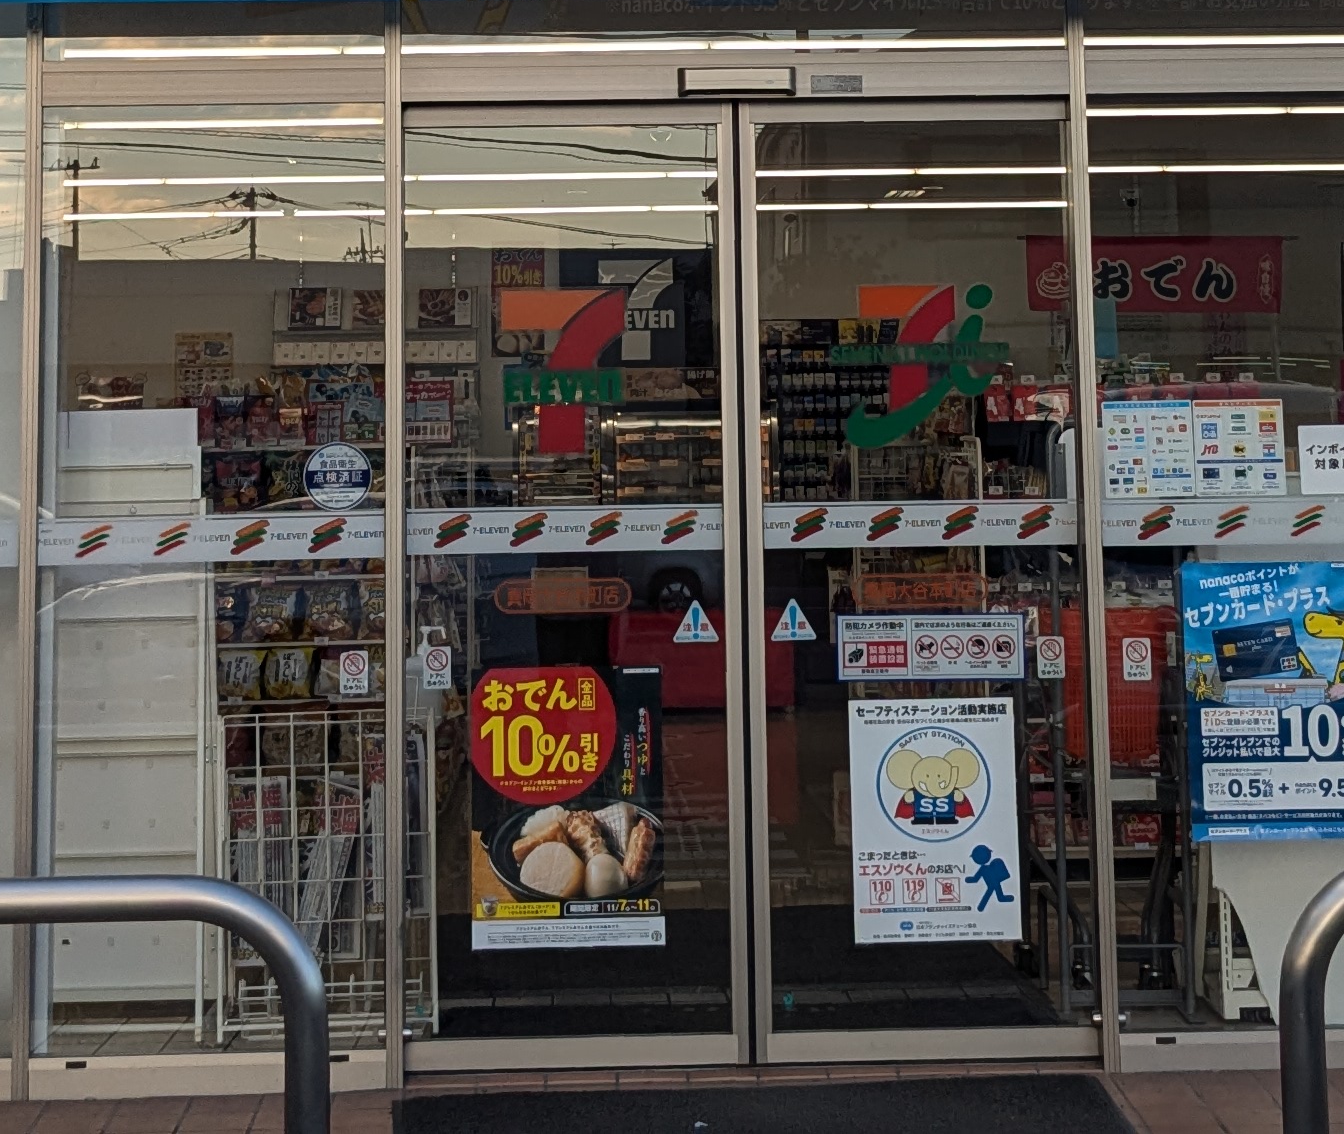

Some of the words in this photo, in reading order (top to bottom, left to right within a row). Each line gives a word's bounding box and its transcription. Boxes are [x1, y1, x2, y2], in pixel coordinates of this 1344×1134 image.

[313, 470, 364, 484] 点検済証
[1199, 563, 1299, 589] nanacoポイントが
[1184, 586, 1330, 628] セブンカード・プラス
[482, 678, 577, 712] おでん
[480, 714, 580, 777] 10%
[580, 732, 599, 772] 引き
[898, 731, 929, 749] SAFETY
[931, 730, 965, 748] STATION
[920, 798, 949, 813] SS
[872, 880, 892, 892] 110
[904, 880, 925, 892] 119
